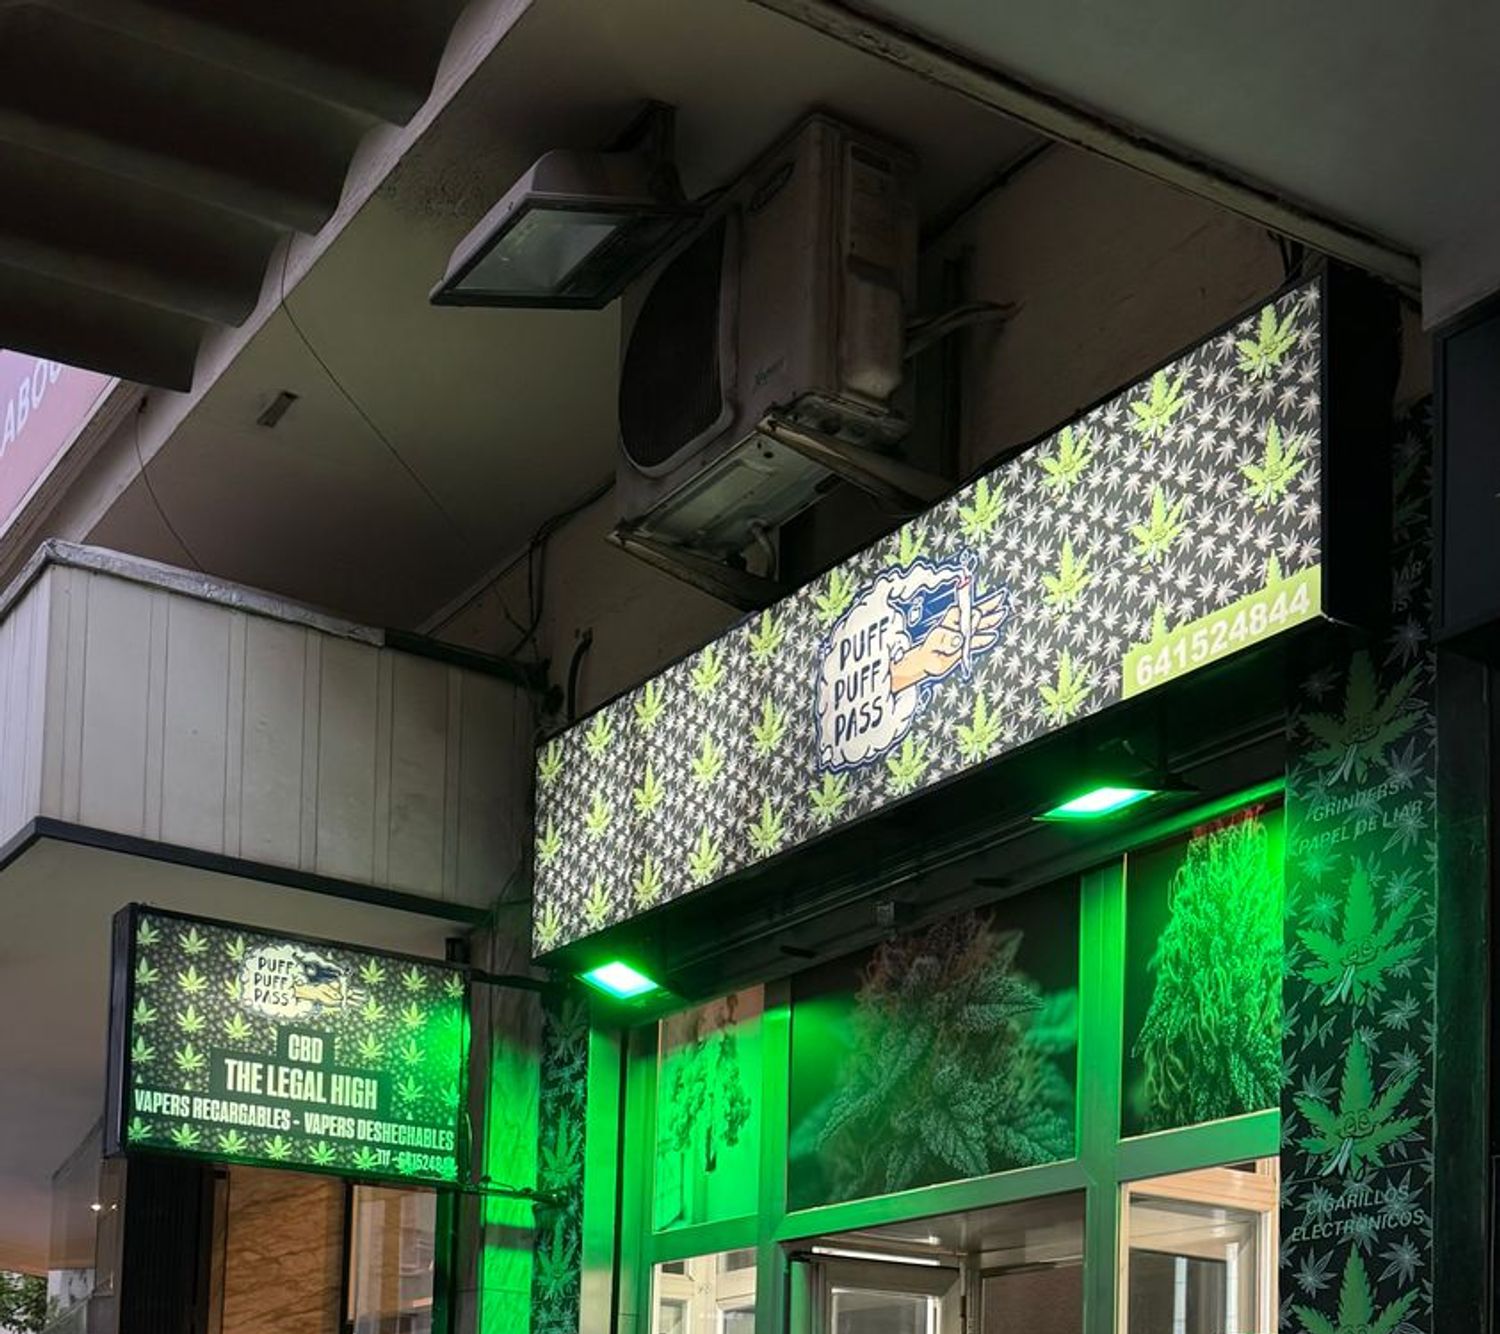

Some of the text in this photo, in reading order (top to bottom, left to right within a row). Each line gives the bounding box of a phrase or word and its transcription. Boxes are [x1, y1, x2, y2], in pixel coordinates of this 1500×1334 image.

[840, 617, 889, 671] PUFF
[1136, 583, 1311, 686] 641524844
[835, 661, 881, 710] PUFF
[835, 698, 883, 746] PASS
[1313, 782, 1399, 822] GRINDERS
[1354, 815, 1377, 839] DE
[254, 972, 288, 990] PUFF
[258, 956, 294, 975] PUFF
[254, 988, 289, 1006] PASS
[288, 1034, 323, 1064] CBD
[225, 1058, 378, 1110] THE LEGAL HIGH
[134, 1089, 190, 1117] VAPERS
[192, 1097, 291, 1131] RECARGABLES
[304, 1112, 355, 1139] VAPERS
[357, 1119, 454, 1151] DESHECHABLES
[1306, 1185, 1409, 1215] CIGARILLOS
